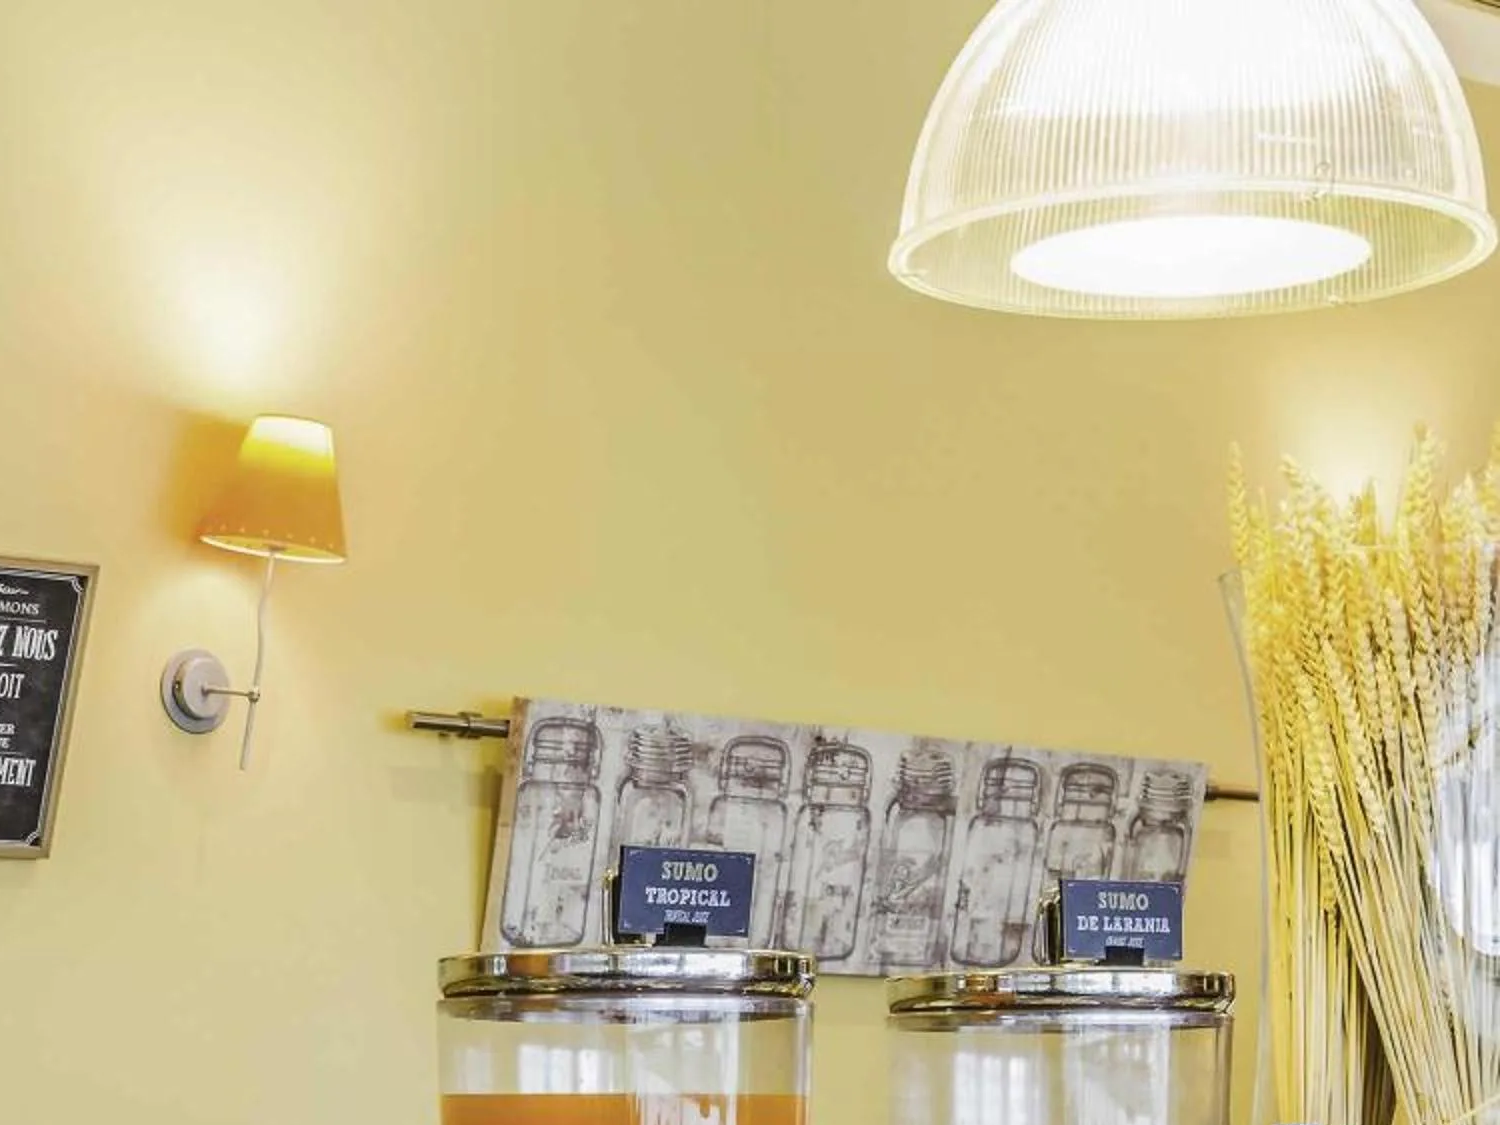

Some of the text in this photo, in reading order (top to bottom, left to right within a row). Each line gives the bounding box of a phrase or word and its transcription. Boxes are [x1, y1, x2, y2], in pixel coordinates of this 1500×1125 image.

[12, 625, 58, 660] NOUS
[661, 861, 719, 882] SUMO
[645, 886, 731, 907] TROPICAL
[1097, 891, 1149, 911] SUMO
[1077, 915, 1099, 931] DE
